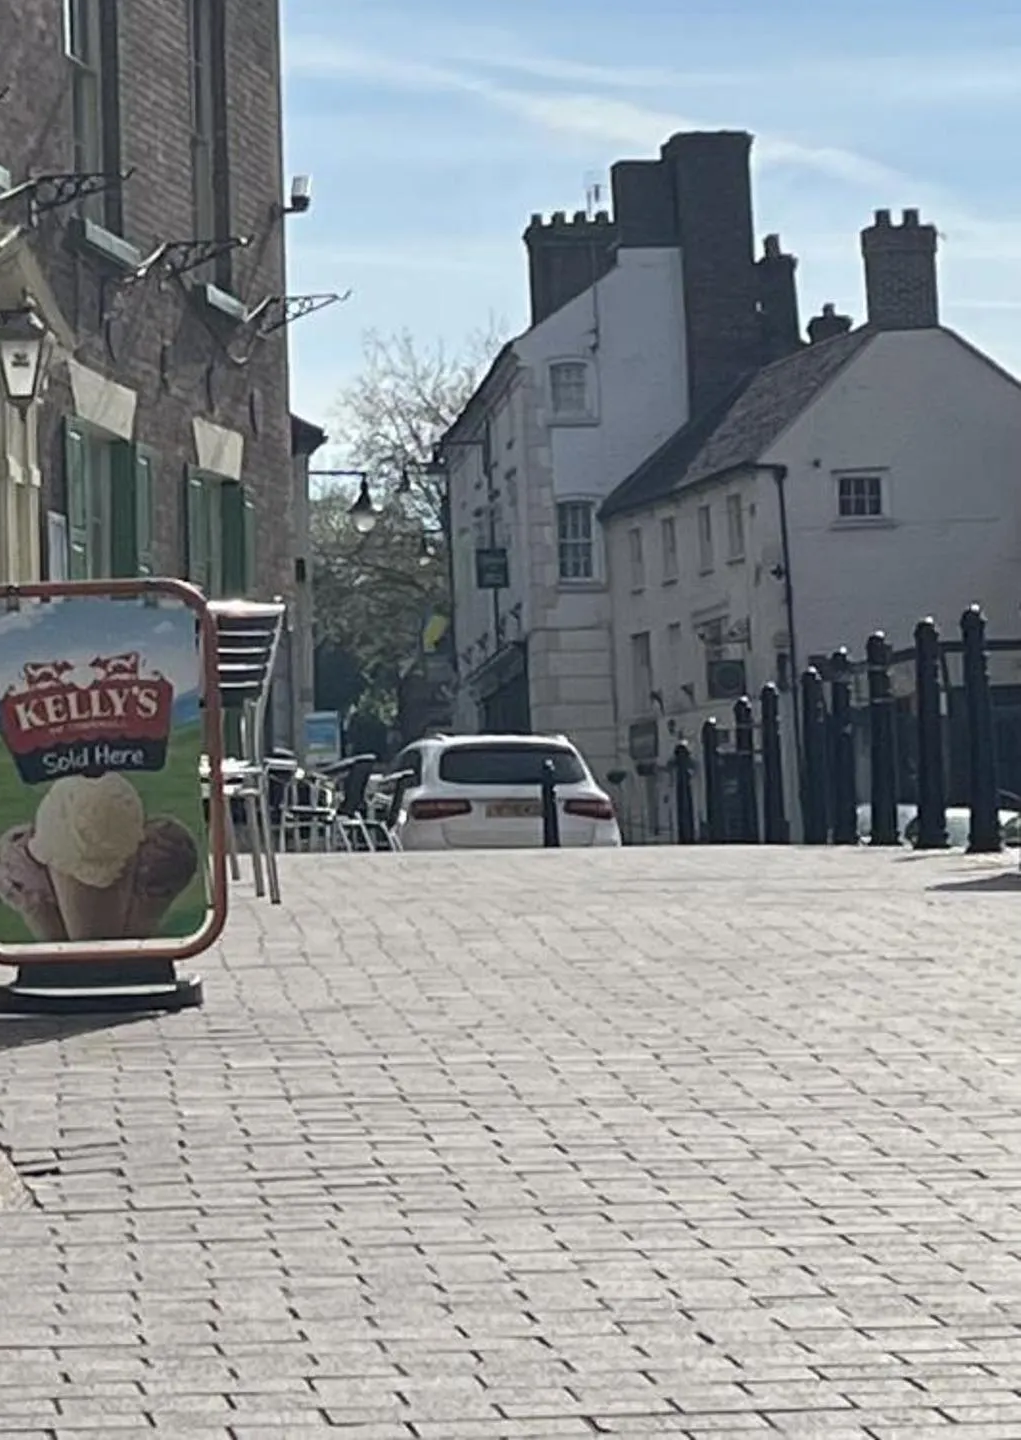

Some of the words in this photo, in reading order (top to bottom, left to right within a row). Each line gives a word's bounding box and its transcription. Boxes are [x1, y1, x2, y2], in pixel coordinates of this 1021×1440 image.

[15, 686, 159, 732] KELLY'S
[42, 746, 89, 774] Sold
[94, 743, 144, 767] Here
